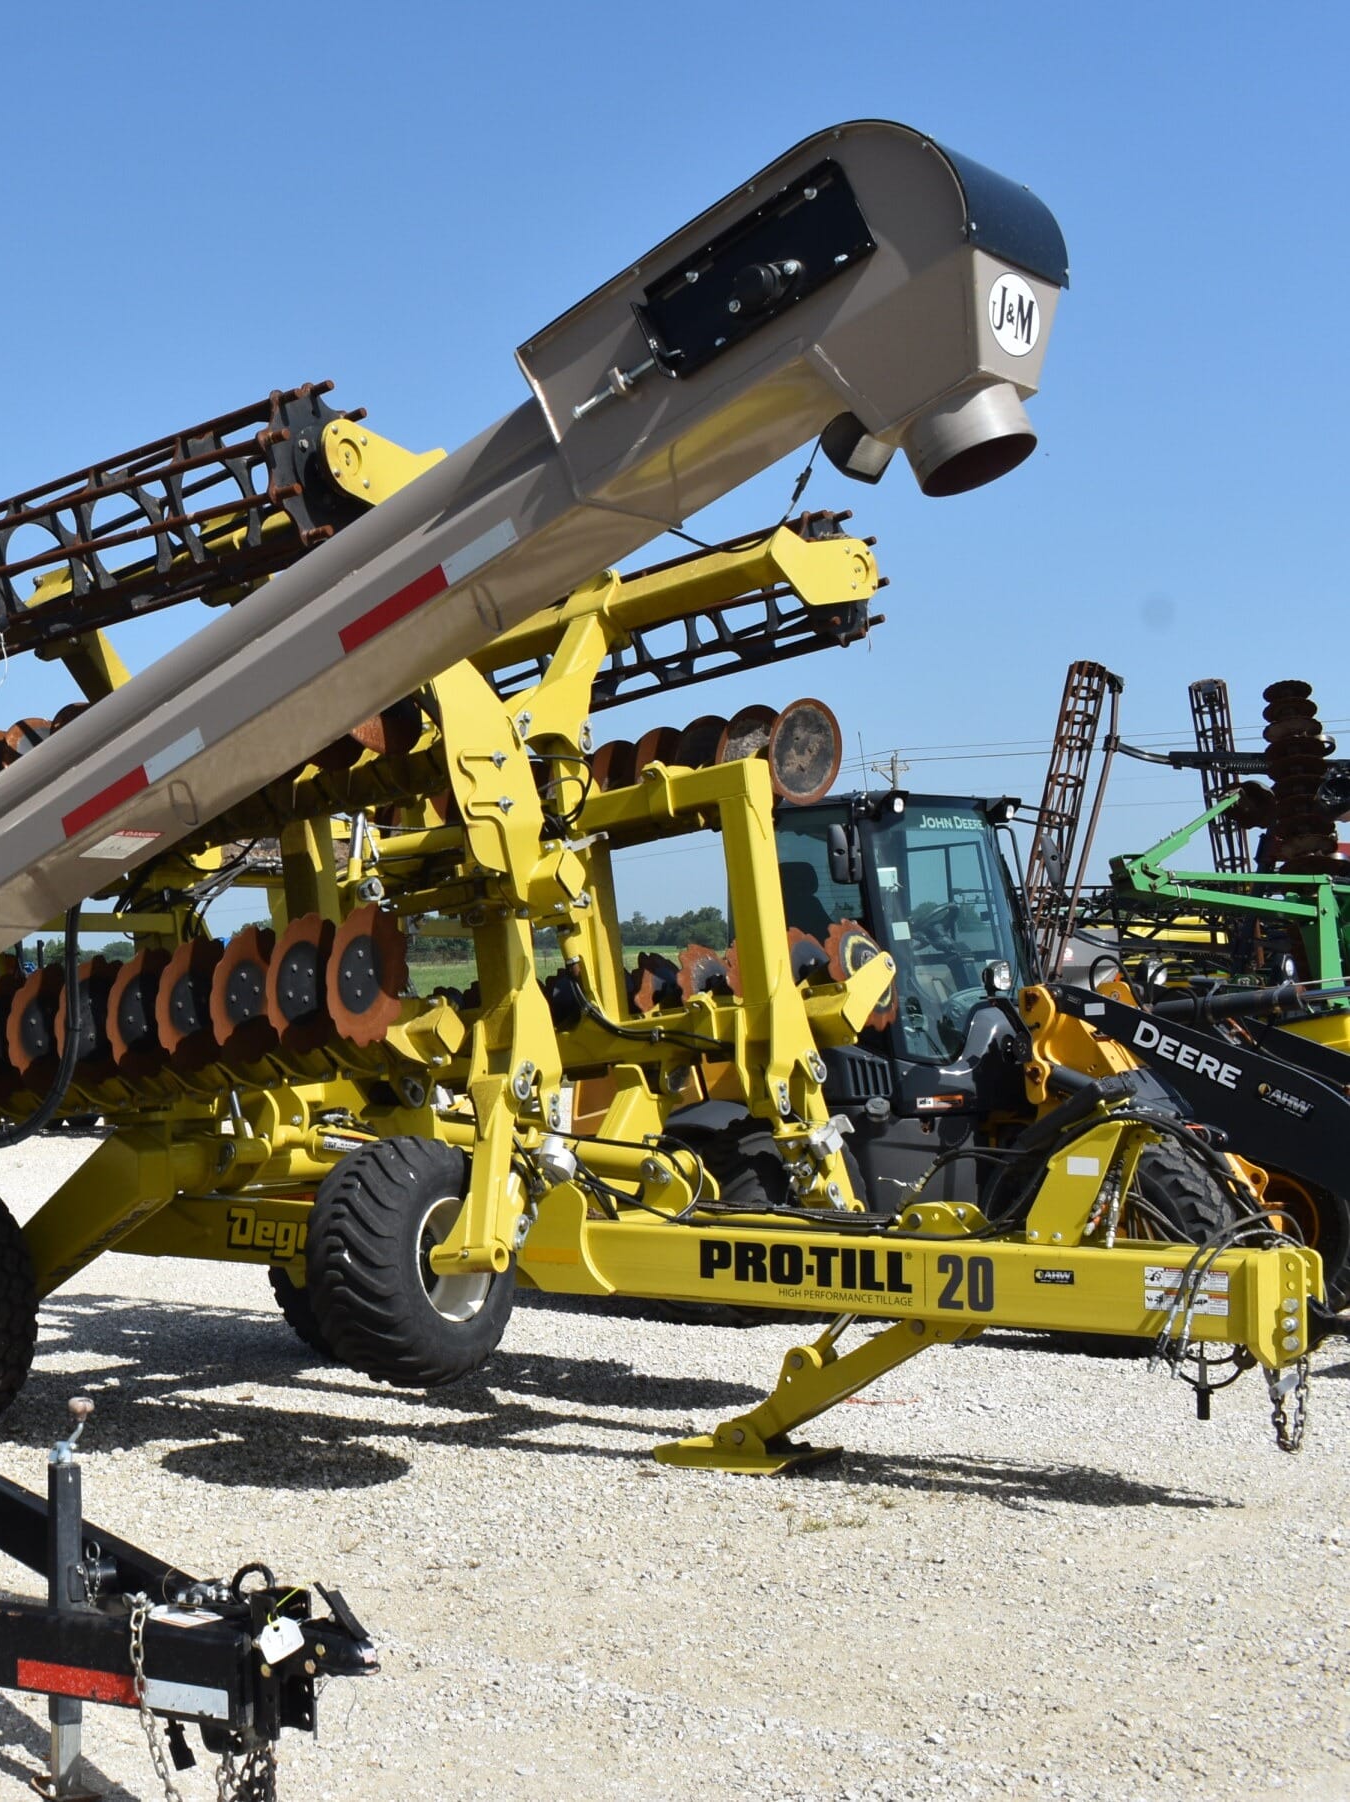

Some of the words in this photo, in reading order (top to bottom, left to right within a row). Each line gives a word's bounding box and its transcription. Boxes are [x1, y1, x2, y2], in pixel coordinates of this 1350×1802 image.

[992, 285, 1035, 346] J&M
[919, 814, 952, 830] JOHN
[953, 815, 985, 831] DEERE
[1132, 1019, 1243, 1090] DEERE
[1269, 1088, 1311, 1114] AHW
[778, 1287, 802, 1298] HIGH
[803, 1289, 873, 1305] PERFORMANCE
[874, 1293, 914, 1307] TILLAGE
[937, 1254, 994, 1312] 20
